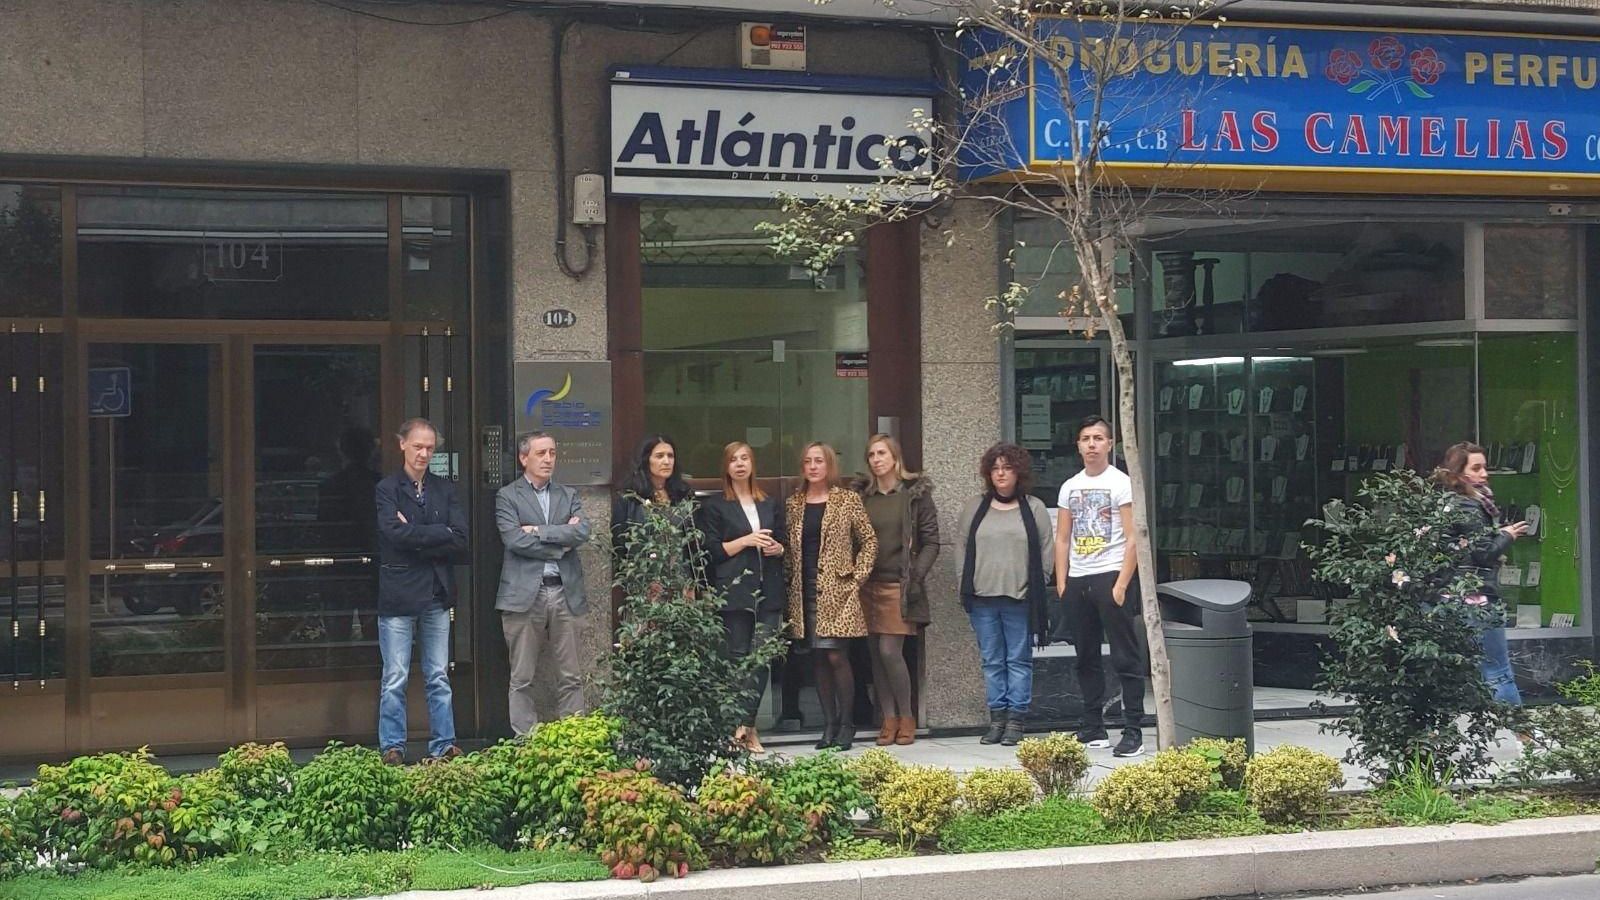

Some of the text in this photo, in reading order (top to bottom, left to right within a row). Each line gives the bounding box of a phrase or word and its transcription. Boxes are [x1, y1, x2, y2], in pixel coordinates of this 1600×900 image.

[1048, 35, 1309, 79] DROGUERÍA
[1465, 52, 1597, 89] PERFU
[617, 110, 928, 171] Atlántico
[1180, 107, 1280, 152] LAS
[1304, 112, 1568, 160] CAMELIAS
[1585, 134, 1600, 161] C
[217, 241, 270, 269] 104
[546, 312, 574, 326] 104
